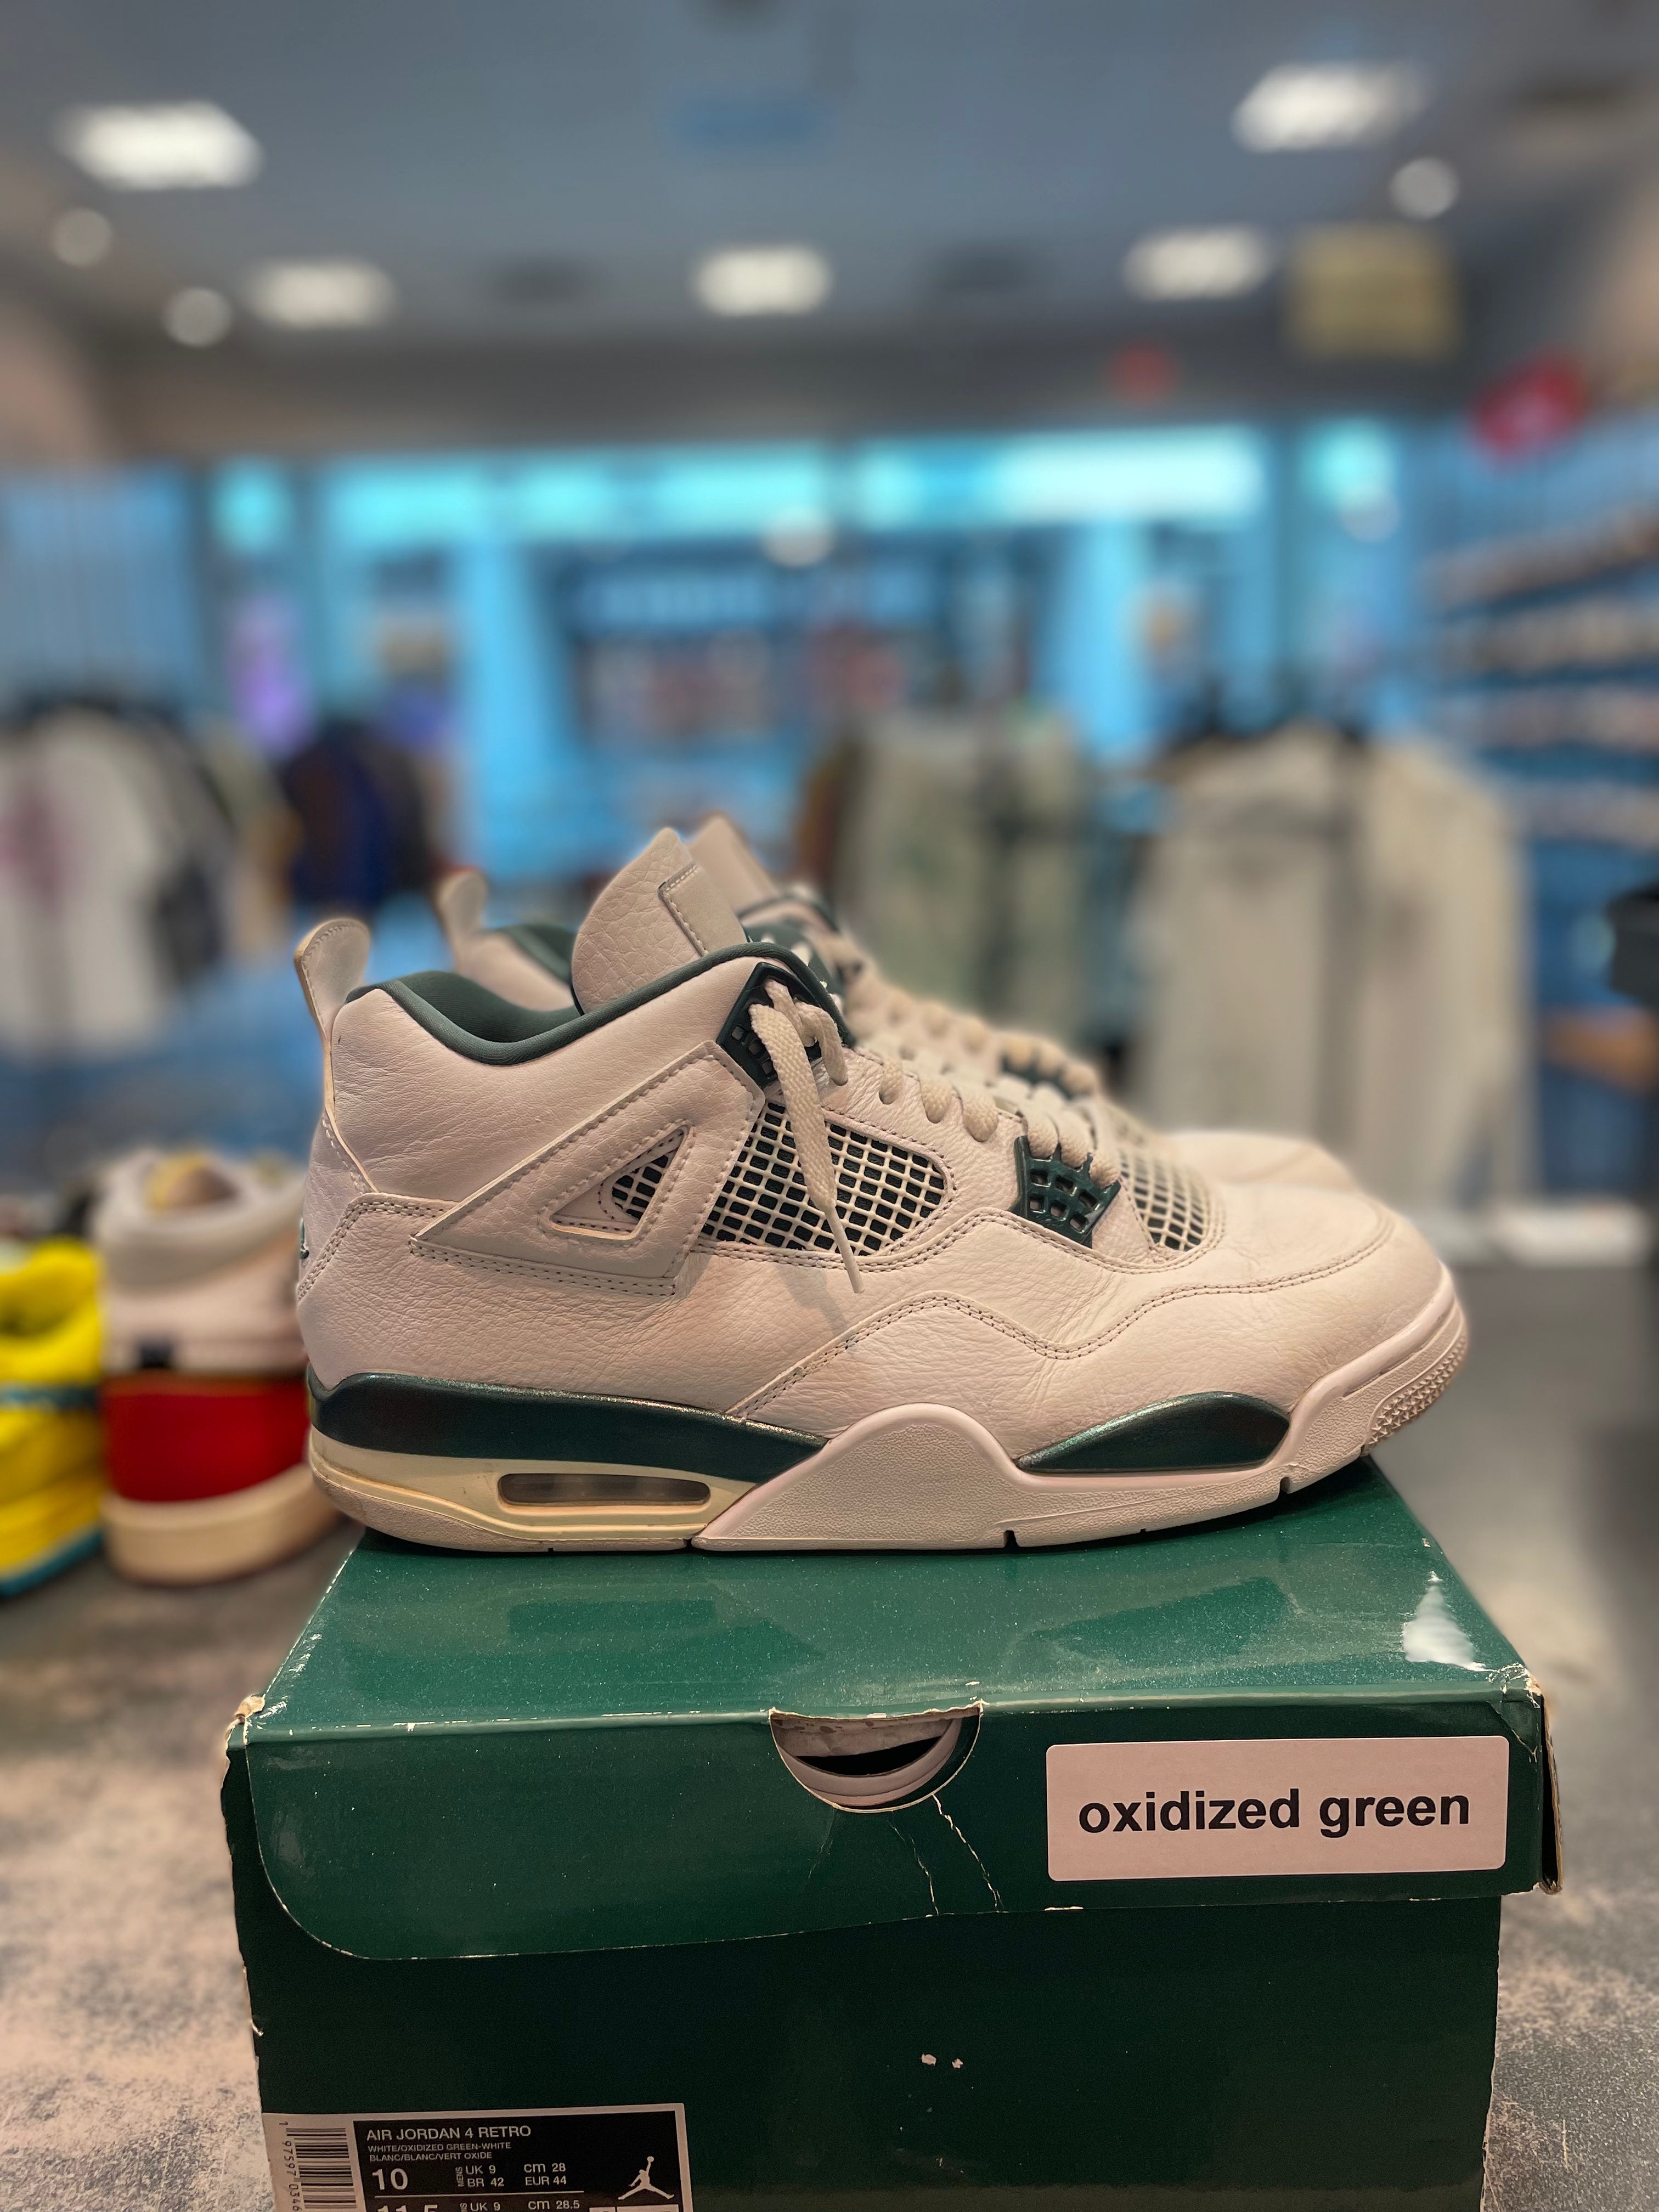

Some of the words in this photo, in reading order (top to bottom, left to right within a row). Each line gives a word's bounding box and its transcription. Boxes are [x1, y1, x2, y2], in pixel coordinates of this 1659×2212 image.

[1079, 1788, 1300, 1833] oxidized
[1319, 1794, 1470, 1838] green
[366, 2129, 392, 2140] AIR
[396, 2128, 460, 2140] JORDAN
[465, 2128, 473, 2138] 4
[478, 2125, 531, 2138] RETRO
[368, 2144, 444, 2153] WHITE/OXIDIZED
[446, 2142, 511, 2151] GREEN-WHITE
[282, 2141, 297, 2176] 97597
[369, 2153, 461, 2162] BLANC/BLANC/VERT
[465, 2165, 483, 2175] UK
[489, 2164, 496, 2174] 9
[523, 2163, 546, 2173] cm
[552, 2163, 566, 2172] 28
[372, 2168, 408, 2191] 10
[467, 2177, 484, 2187] BR
[490, 2177, 504, 2187] 42
[525, 2177, 550, 2186] EUR
[552, 2175, 567, 2185] 44
[470, 2202, 488, 2212] UK
[493, 2202, 500, 2211] 9
[528, 2200, 550, 2210] cm
[556, 2200, 580, 2210] 28.5
